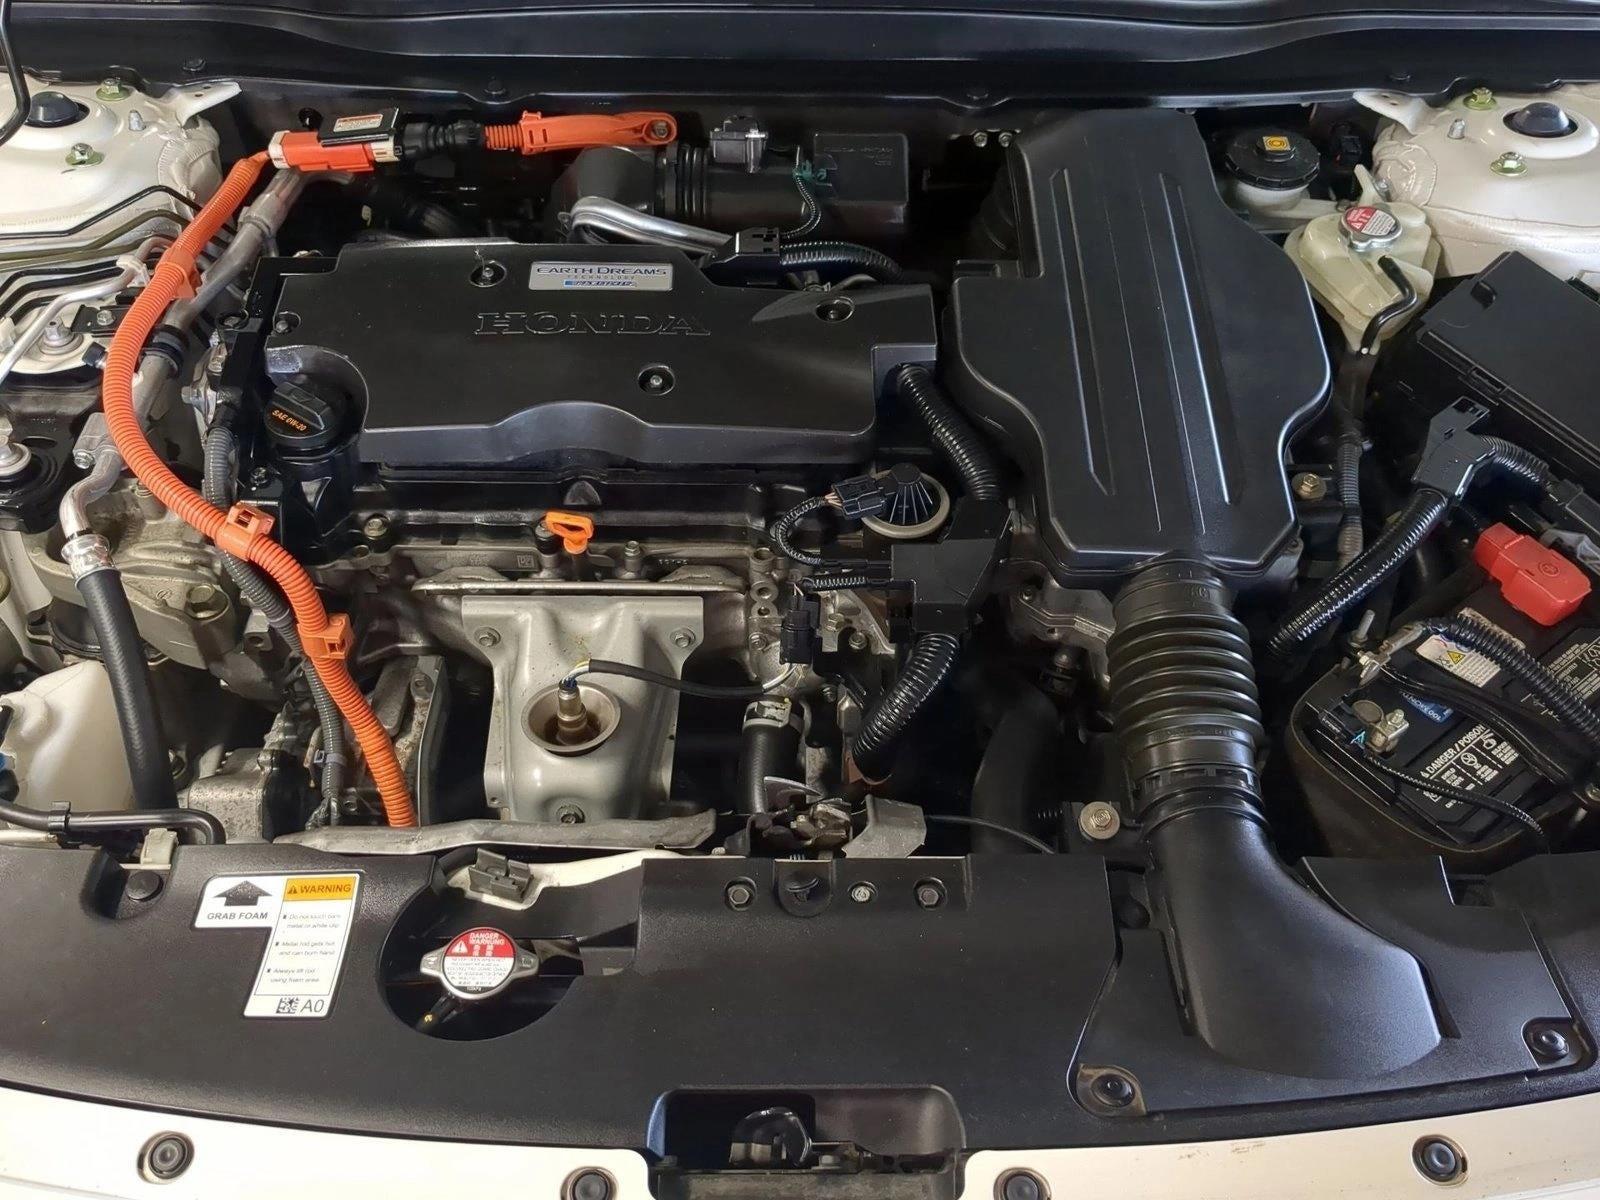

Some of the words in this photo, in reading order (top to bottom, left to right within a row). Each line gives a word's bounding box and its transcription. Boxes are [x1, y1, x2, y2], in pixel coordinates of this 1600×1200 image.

[597, 266, 667, 275] DREAMS
[475, 311, 711, 336] HONDA
[272, 409, 288, 421] SAE
[286, 417, 307, 431] 0W-20
[1425, 748, 1457, 774] DANGER
[1458, 723, 1486, 747] POISON
[299, 884, 351, 894] WARNING
[207, 912, 236, 920] GRAB
[238, 911, 268, 920] FOAM
[300, 999, 325, 1013] A0
